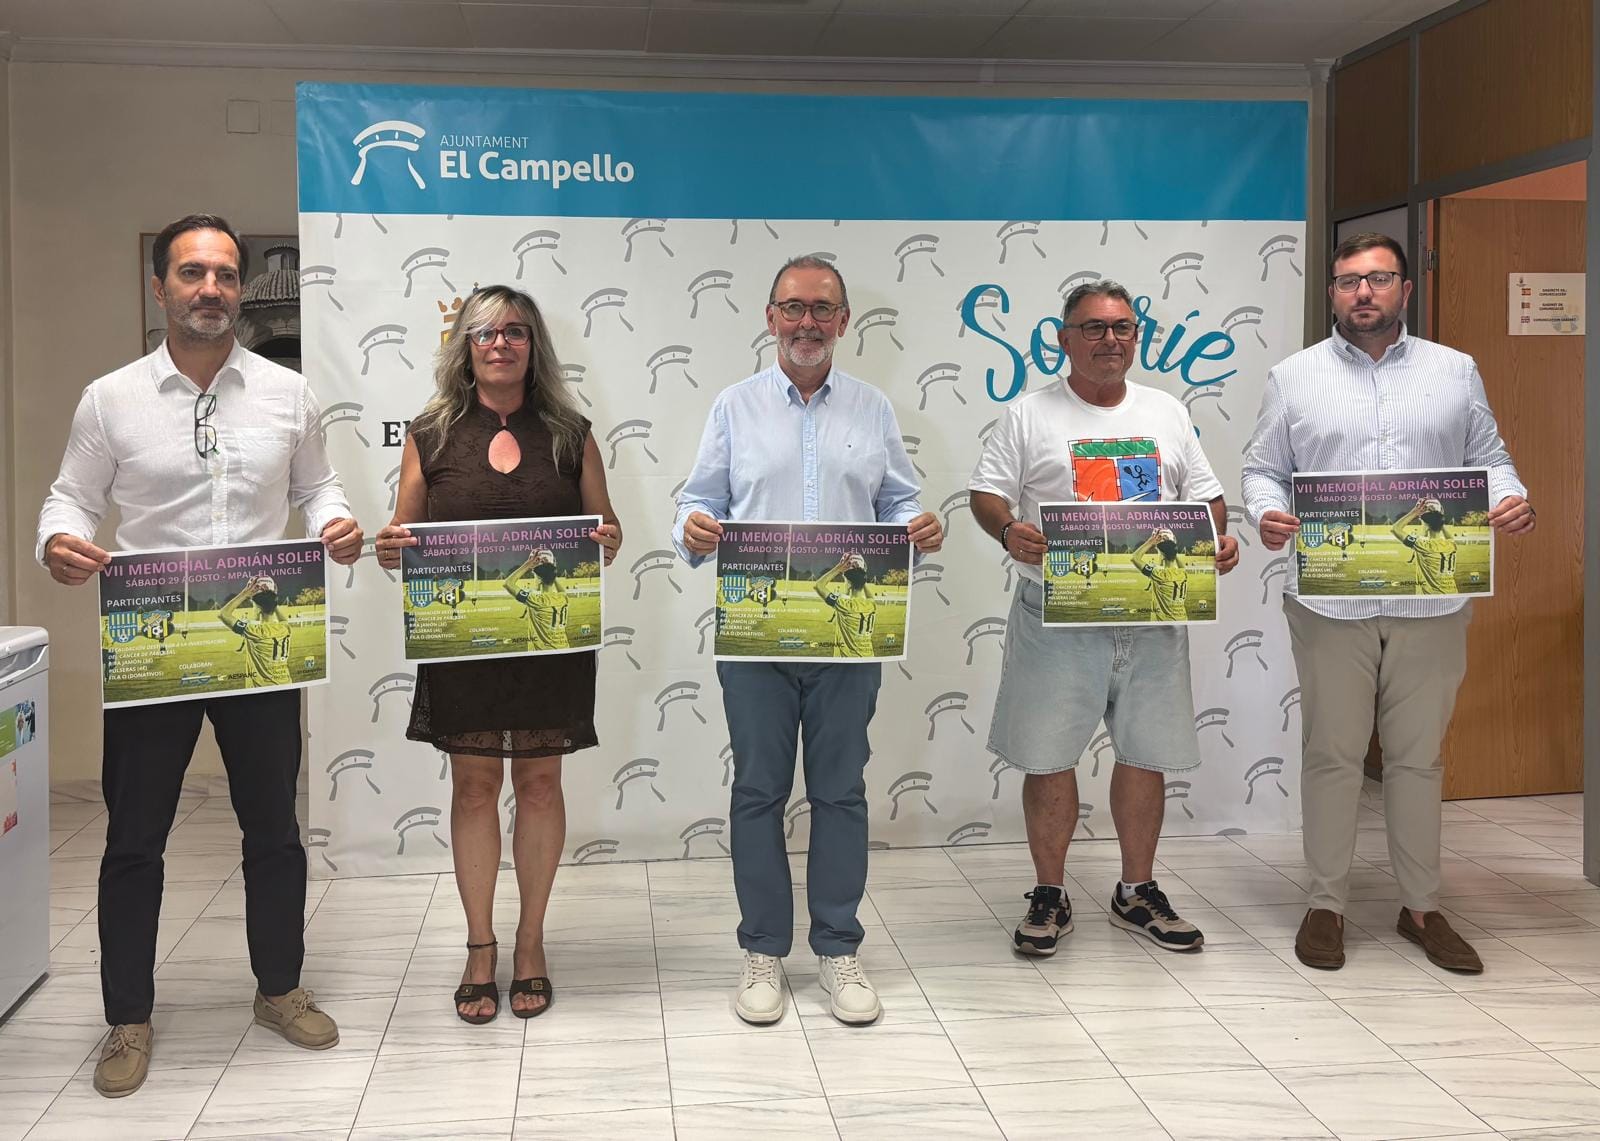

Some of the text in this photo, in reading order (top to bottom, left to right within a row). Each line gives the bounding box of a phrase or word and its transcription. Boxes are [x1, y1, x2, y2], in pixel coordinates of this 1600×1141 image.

[440, 135, 528, 149] AJUNTAMENT
[440, 150, 635, 189] El Campello
[961, 284, 1237, 403] Soríe
[1296, 476, 1484, 493] VII MEMORIAL ADRIÁN SOLER
[1313, 493, 1346, 502] SÁBADO
[1044, 509, 1208, 522] VII MEMORIAL ADRIÁN SOLER
[1299, 510, 1359, 518] PARTICIPANTES
[1060, 522, 1091, 532] SÁBADO
[425, 532, 497, 545] MEMORIAL
[502, 526, 552, 541] ADRIÁN
[720, 530, 907, 544] VII MEMORIAL ADRIÁN SOLER
[422, 546, 457, 556] SÁBADO
[470, 545, 504, 554] AGOSTO
[550, 541, 578, 549] VINCLE
[738, 544, 771, 553] SÁBADO
[103, 551, 321, 577] VII MEMORIAL ADRIÁN SOLER
[407, 564, 471, 574] PARTICIPANTES
[722, 562, 784, 570] PARTICIPANTES
[125, 574, 165, 587] SÁBADO
[168, 576, 178, 584] 29
[181, 572, 219, 582] AGOSTO
[271, 567, 302, 576] VINCLE
[107, 594, 181, 607] PARTICIPANTES
